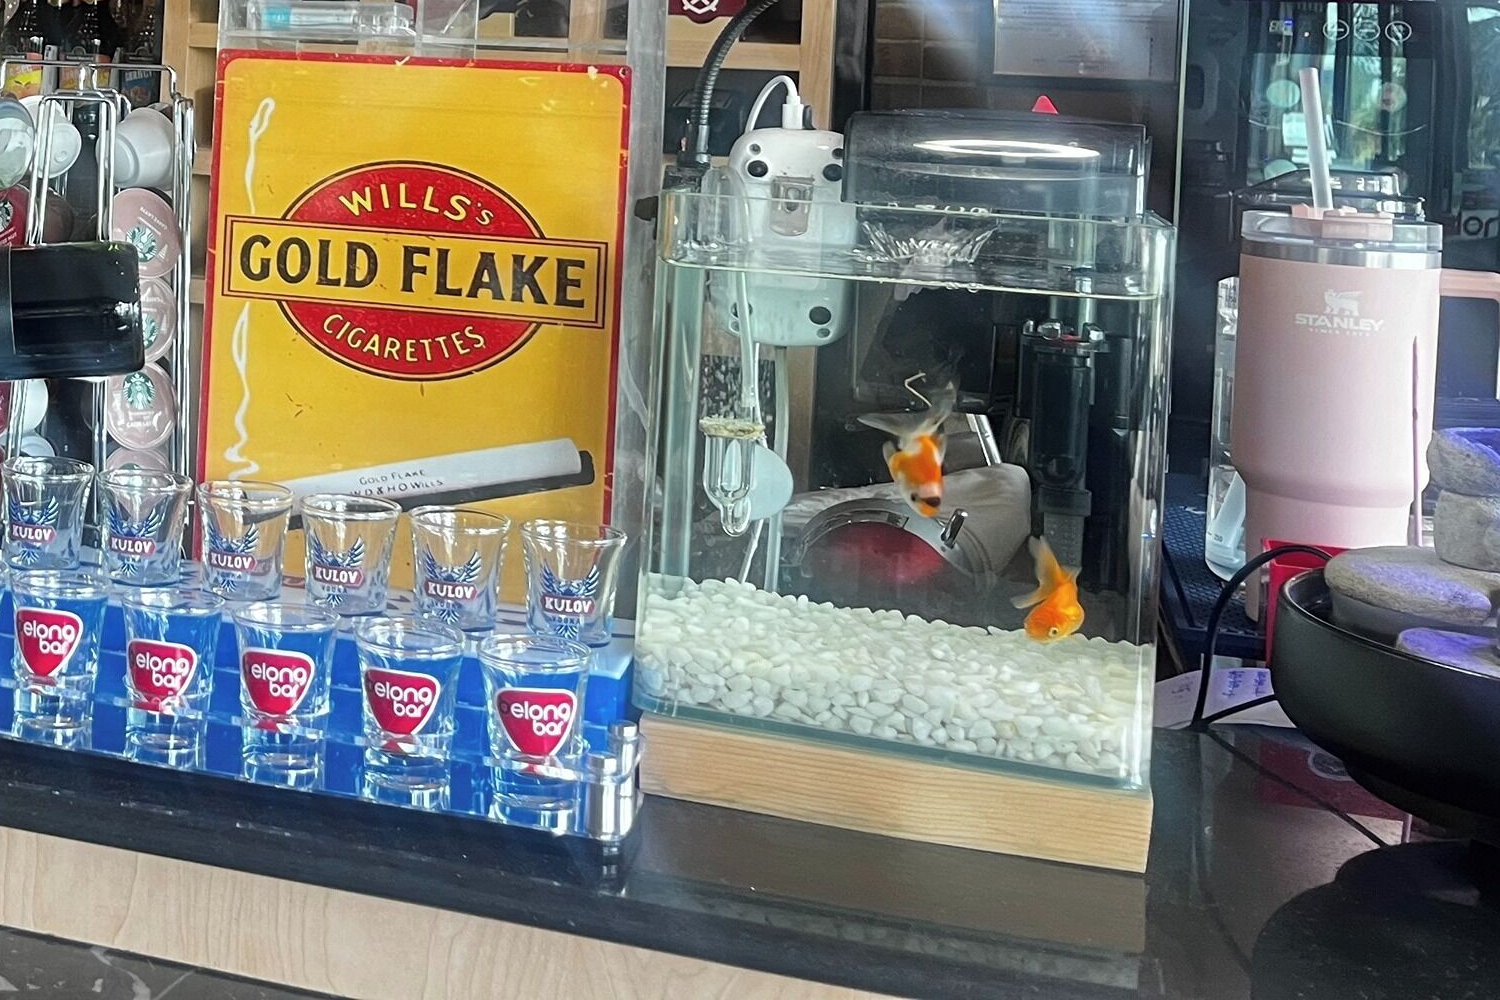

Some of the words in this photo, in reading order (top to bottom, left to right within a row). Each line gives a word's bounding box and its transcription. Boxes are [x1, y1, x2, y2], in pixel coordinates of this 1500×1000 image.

[239, 234, 380, 290] GOLD
[399, 245, 586, 309] FLAKE
[1294, 313, 1385, 332] STANLEY
[322, 313, 486, 363] CIGARETTES
[359, 475, 388, 486] GOLD
[391, 469, 427, 480] FLAKE
[11, 524, 53, 542] KULOV
[110, 537, 152, 555] KULOV
[210, 551, 253, 569] KULOV
[314, 566, 359, 585] KULOV
[427, 581, 474, 600] KULOV
[544, 596, 592, 614] KULOV
[39, 638, 69, 655] bar
[152, 671, 183, 689] bar
[269, 681, 300, 698] bar
[393, 700, 426, 718] bar
[532, 718, 565, 737] bar
